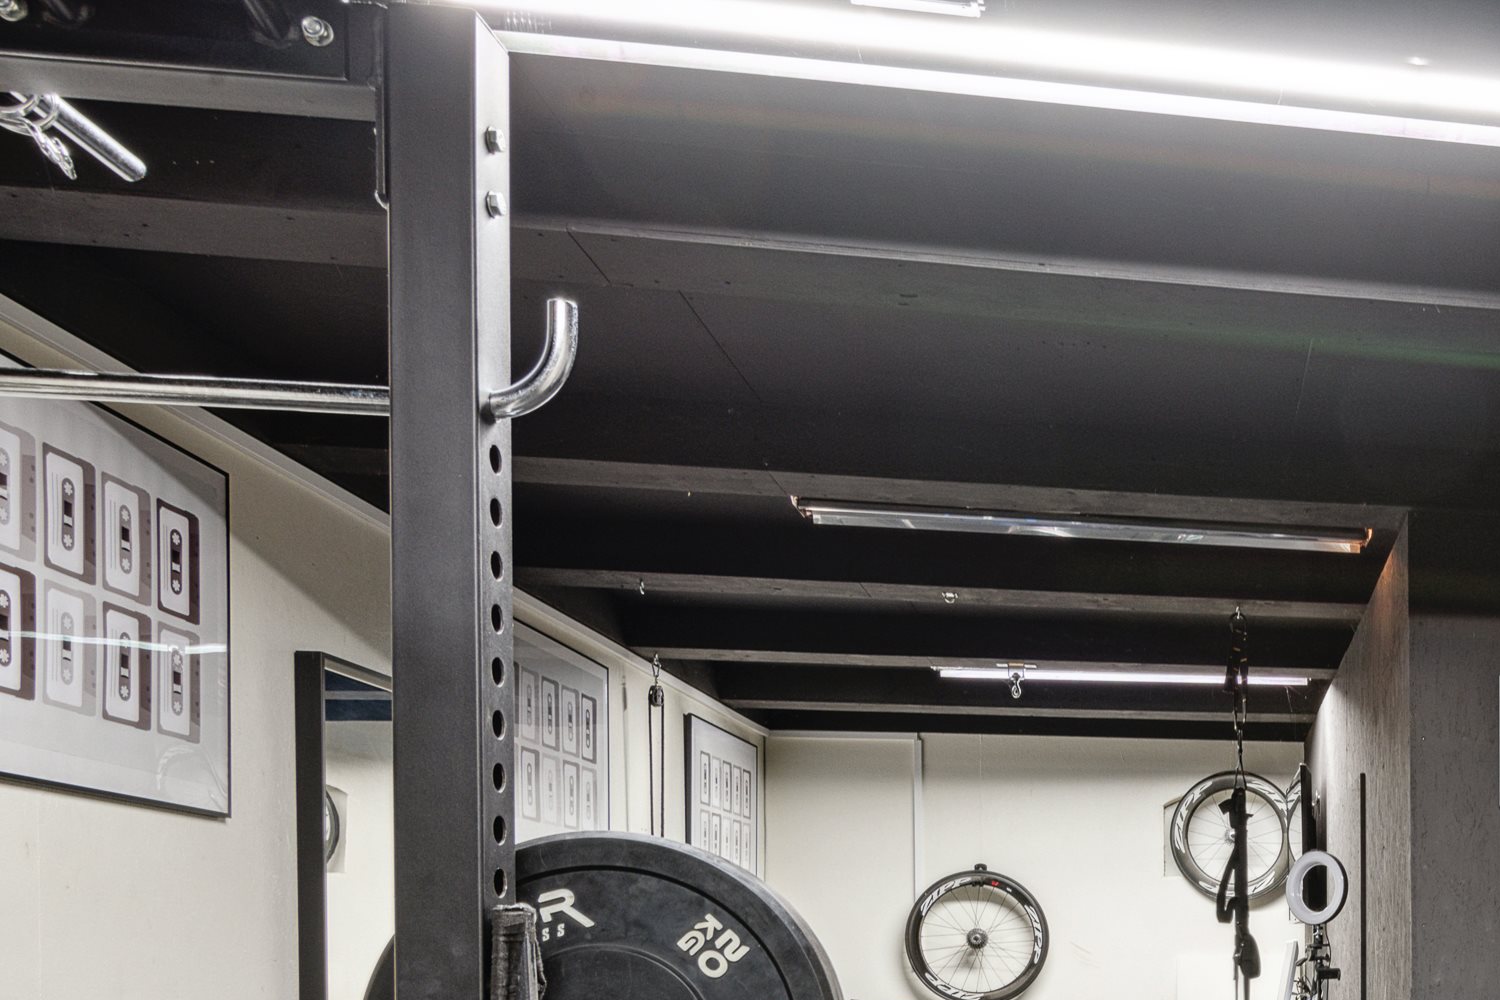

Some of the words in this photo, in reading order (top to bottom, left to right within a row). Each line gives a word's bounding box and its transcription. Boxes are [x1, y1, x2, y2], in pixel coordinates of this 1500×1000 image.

[920, 877, 972, 916] ZIPP
[677, 913, 724, 956] KG
[697, 929, 750, 978] 20
[1023, 904, 1044, 964] ZIPP
[924, 972, 985, 1000] ZIPP
